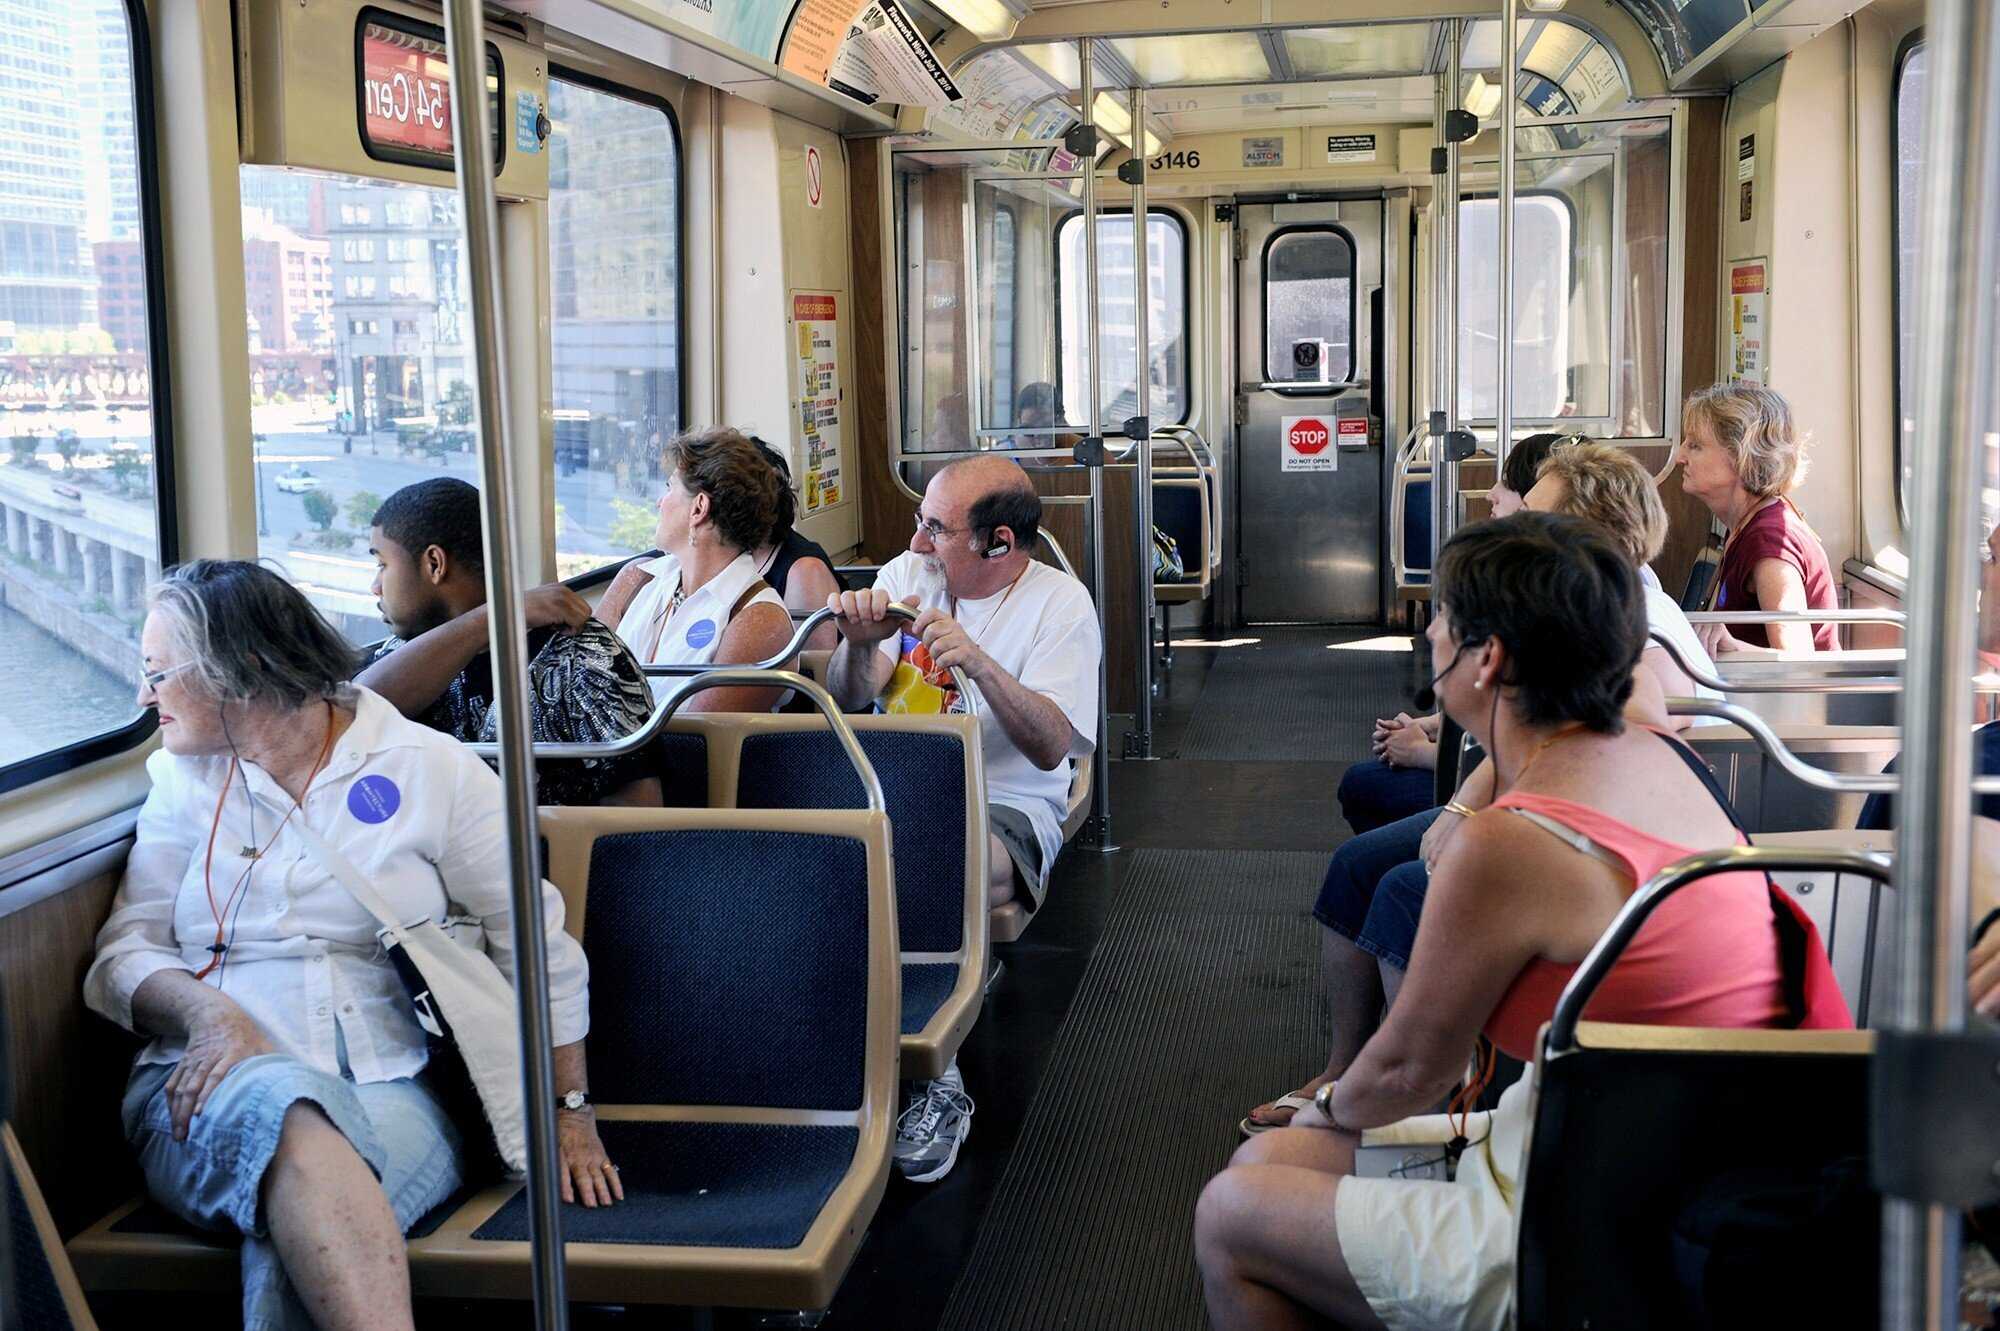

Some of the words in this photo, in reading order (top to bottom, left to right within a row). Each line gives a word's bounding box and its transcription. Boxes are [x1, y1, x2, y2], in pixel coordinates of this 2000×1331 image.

[886, 6, 914, 43] Fireworks
[911, 40, 927, 60] Night
[923, 57, 937, 75] July
[939, 76, 952, 92] 2010
[1246, 152, 1281, 161] ALSTOM
[1291, 431, 1326, 444] STOP
